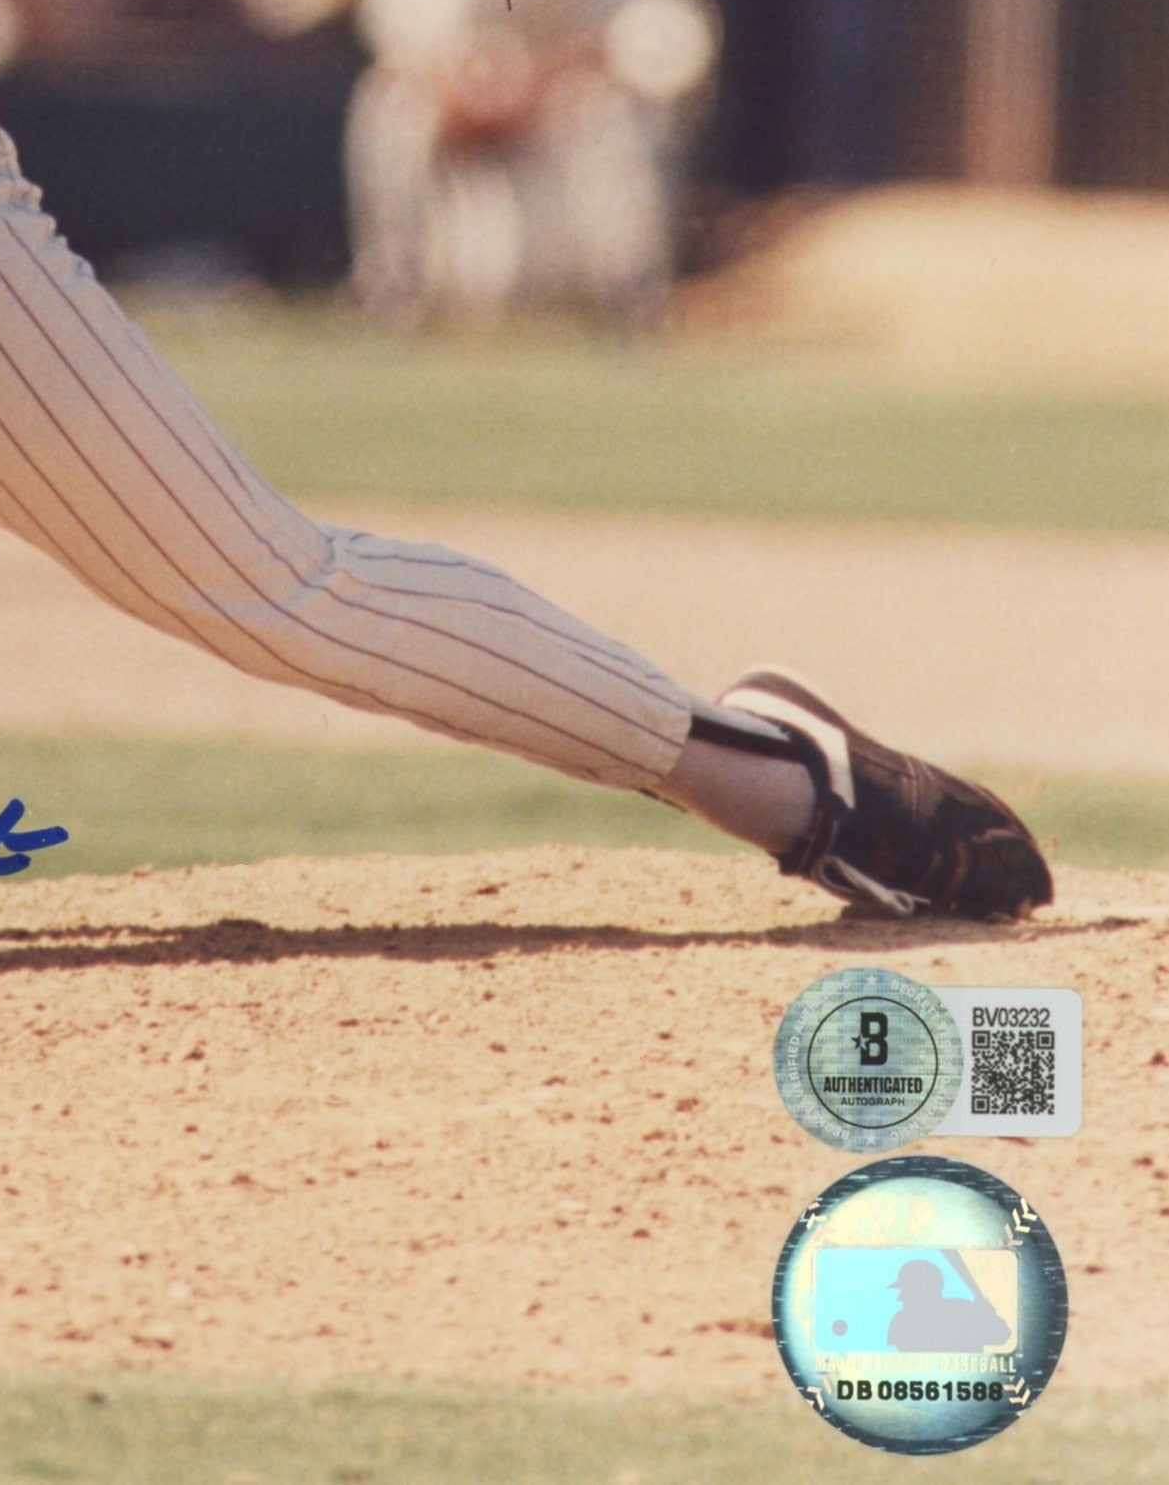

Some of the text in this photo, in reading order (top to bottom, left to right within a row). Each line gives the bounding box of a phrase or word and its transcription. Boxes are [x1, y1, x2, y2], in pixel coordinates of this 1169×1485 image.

[972, 1007, 1051, 1028] BV03232
[860, 1011, 889, 1065] B
[823, 1077, 923, 1095] AUTHENTICATED
[840, 1097, 906, 1107] AUTOGRAPH
[939, 1355, 1017, 1373] BASEBALL
[837, 1380, 1004, 1402] DB 08561588
